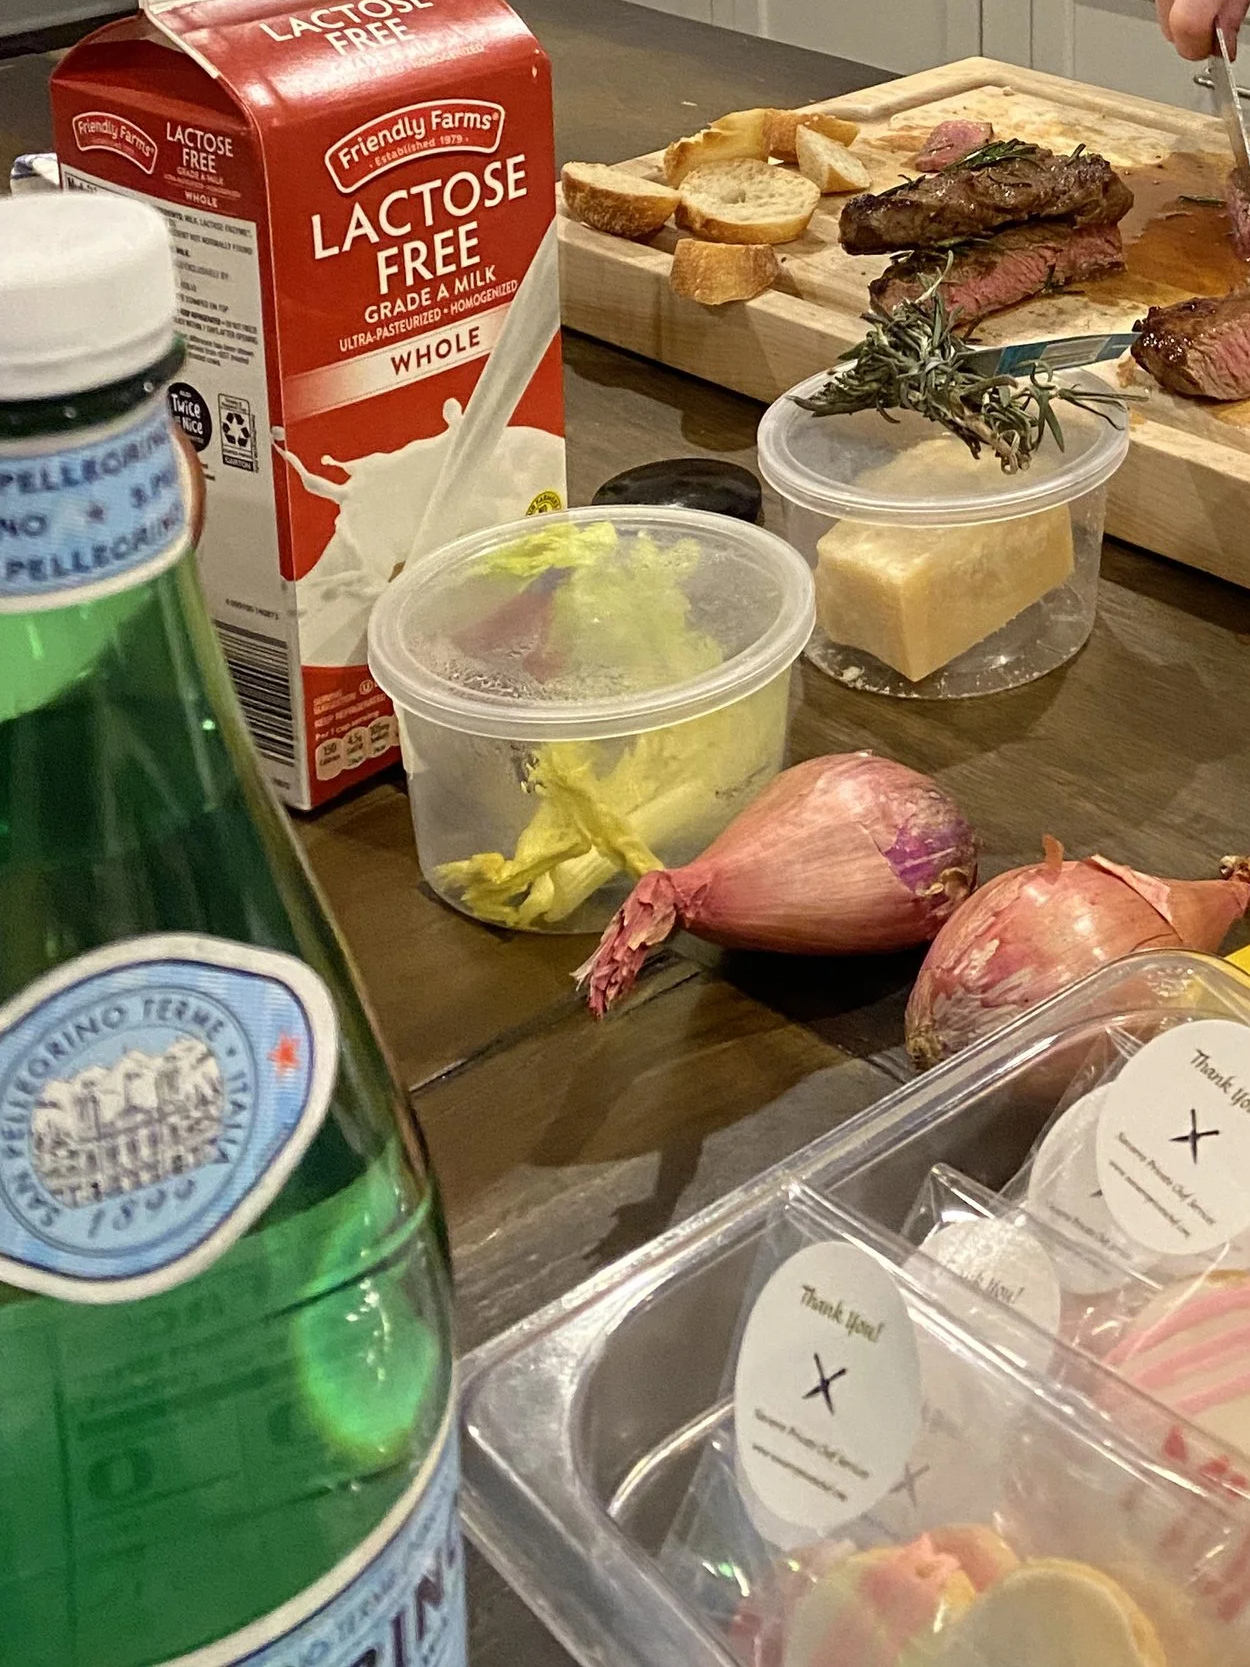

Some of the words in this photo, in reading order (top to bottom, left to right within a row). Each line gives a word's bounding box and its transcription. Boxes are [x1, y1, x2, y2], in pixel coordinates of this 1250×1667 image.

[324, 17, 417, 57] FREE
[77, 120, 117, 140] Friendly
[119, 126, 151, 158] Farms
[166, 121, 234, 158] LACTOSE
[182, 148, 217, 174] FREE
[338, 117, 425, 170] Friendly
[431, 110, 492, 131] Farms
[375, 138, 436, 167] Established
[440, 134, 463, 146] 1979
[184, 190, 218, 209] WHOLE
[311, 153, 527, 260] LACTOSE
[377, 221, 481, 296] FREE
[339, 308, 441, 352] ULTRA-PASTEURIZED
[450, 279, 518, 316] HOMOGENIZED
[364, 287, 431, 324] GRADE
[436, 282, 450, 302] A
[454, 264, 496, 296] MILK
[391, 326, 481, 376] WHOLE
[171, 393, 201, 419] Twice
[182, 416, 203, 435] Nice
[143, 996, 226, 1042] TERME
[1189, 1048, 1235, 1095] Thank
[801, 1284, 844, 1324] Thank
[845, 1309, 885, 1343] You!
